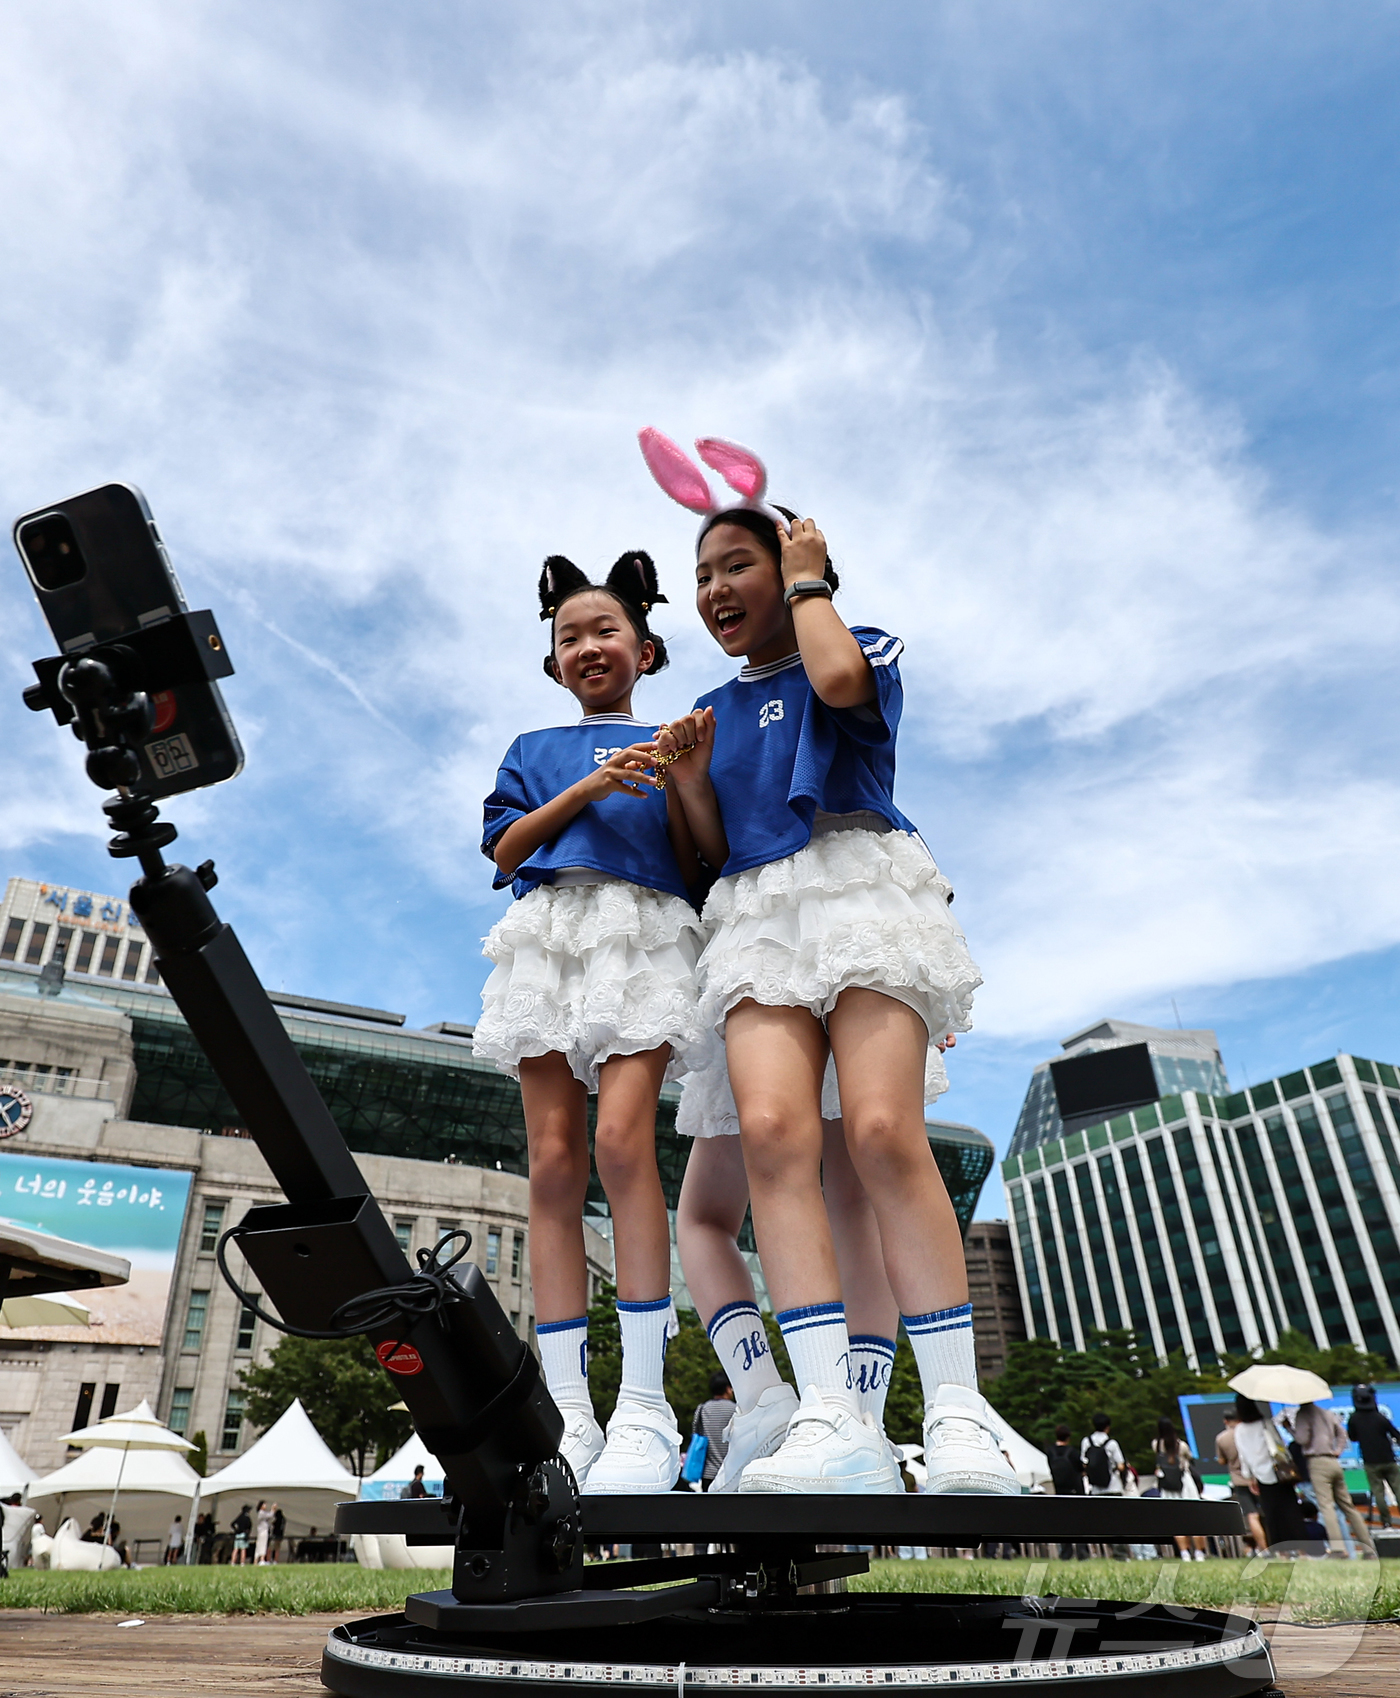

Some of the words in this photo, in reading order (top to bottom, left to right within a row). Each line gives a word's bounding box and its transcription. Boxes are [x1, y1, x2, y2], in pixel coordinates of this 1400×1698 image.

[759, 700, 784, 728] 23
[15, 1173, 66, 1199] 너의
[77, 1178, 165, 1211] 웃음이야.
